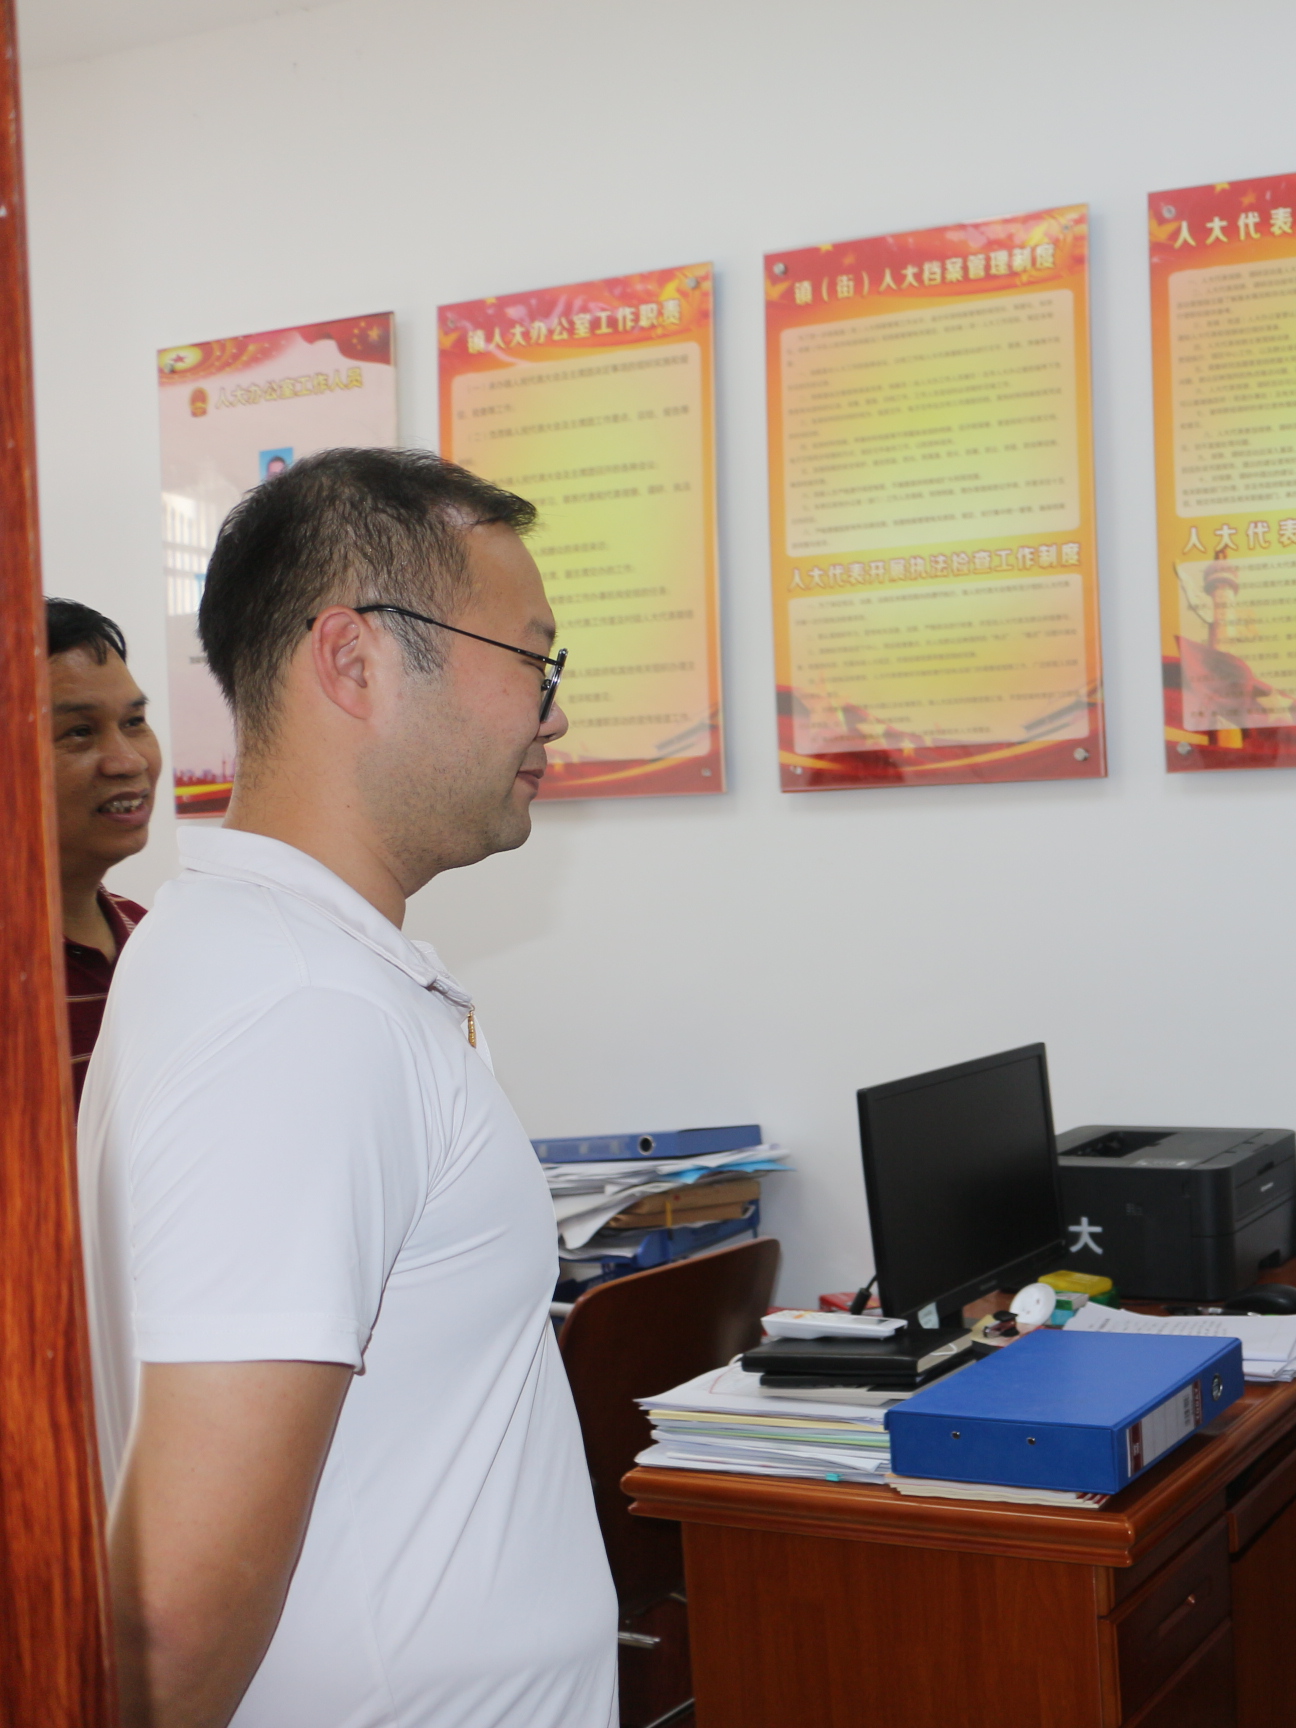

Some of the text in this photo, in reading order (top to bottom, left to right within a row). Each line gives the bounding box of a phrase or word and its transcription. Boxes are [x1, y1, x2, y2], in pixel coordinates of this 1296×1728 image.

[793, 243, 1057, 306] 镇（街）人大档案管理制度
[466, 298, 681, 354] 镇人大办公室工作职责
[214, 366, 363, 410] 人大办公室工作人员
[787, 541, 1081, 592] 人大代表开展执法检查工作制度
[1067, 1216, 1104, 1255] 大
